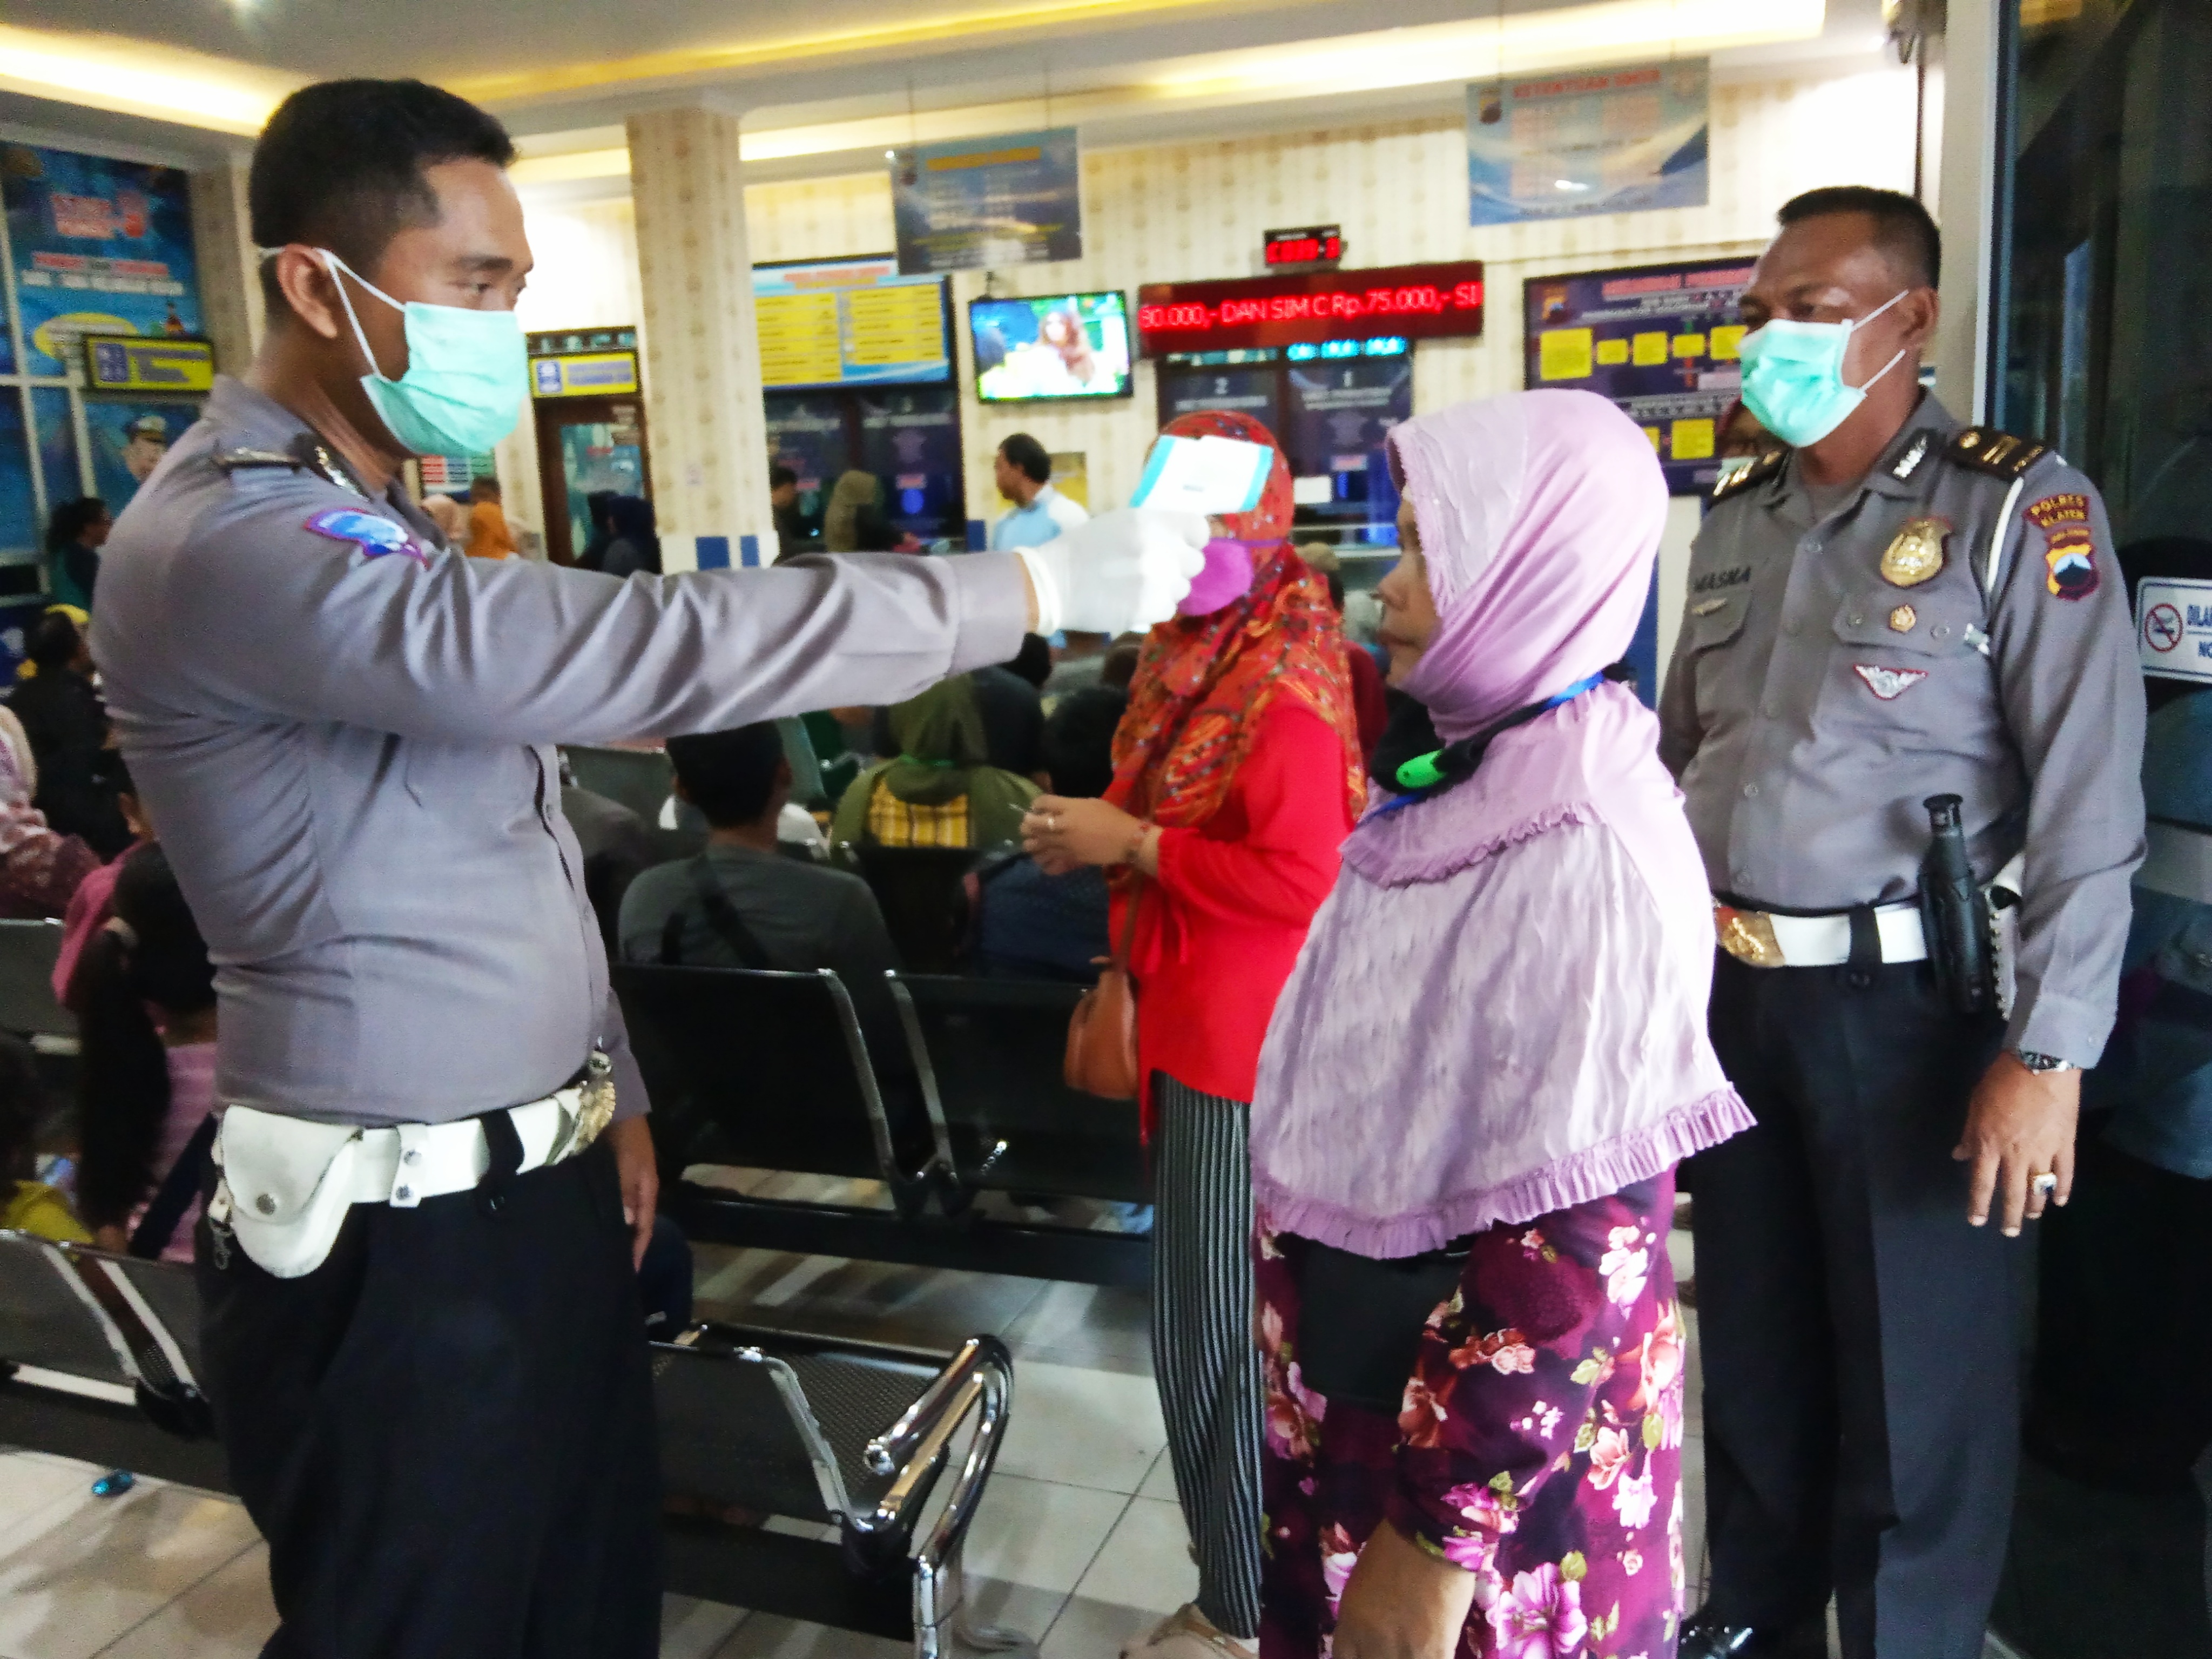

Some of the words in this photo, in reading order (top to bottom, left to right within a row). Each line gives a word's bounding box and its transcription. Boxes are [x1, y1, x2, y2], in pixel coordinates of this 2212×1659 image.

[1220, 300, 1267, 326] DAN
[1270, 296, 1310, 320] SIM
[1311, 295, 1330, 317] C
